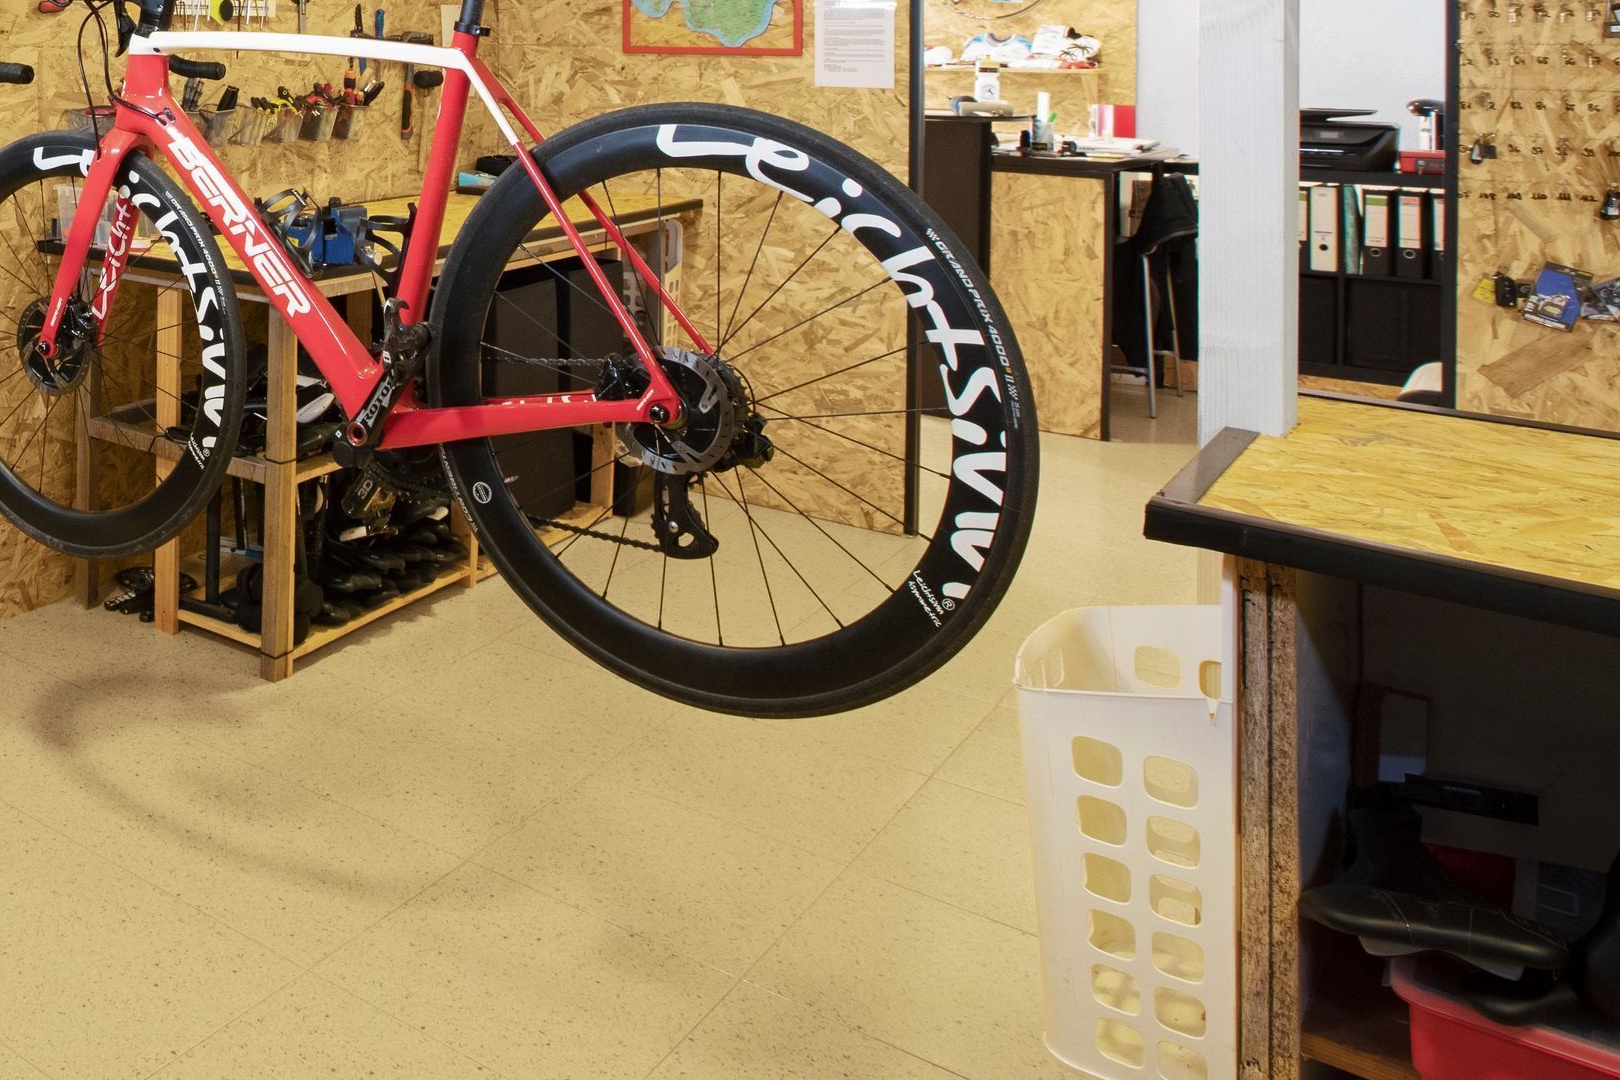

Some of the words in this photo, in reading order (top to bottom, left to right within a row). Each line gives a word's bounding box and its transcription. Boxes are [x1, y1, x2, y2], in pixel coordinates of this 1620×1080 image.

[167, 136, 312, 318] BERNER
[32, 146, 229, 447] Lichtsinn
[935, 240, 975, 289] GRAND
[967, 287, 994, 324] PRIX
[357, 479, 374, 500] 3D
[913, 570, 945, 616] Leichtsinn
